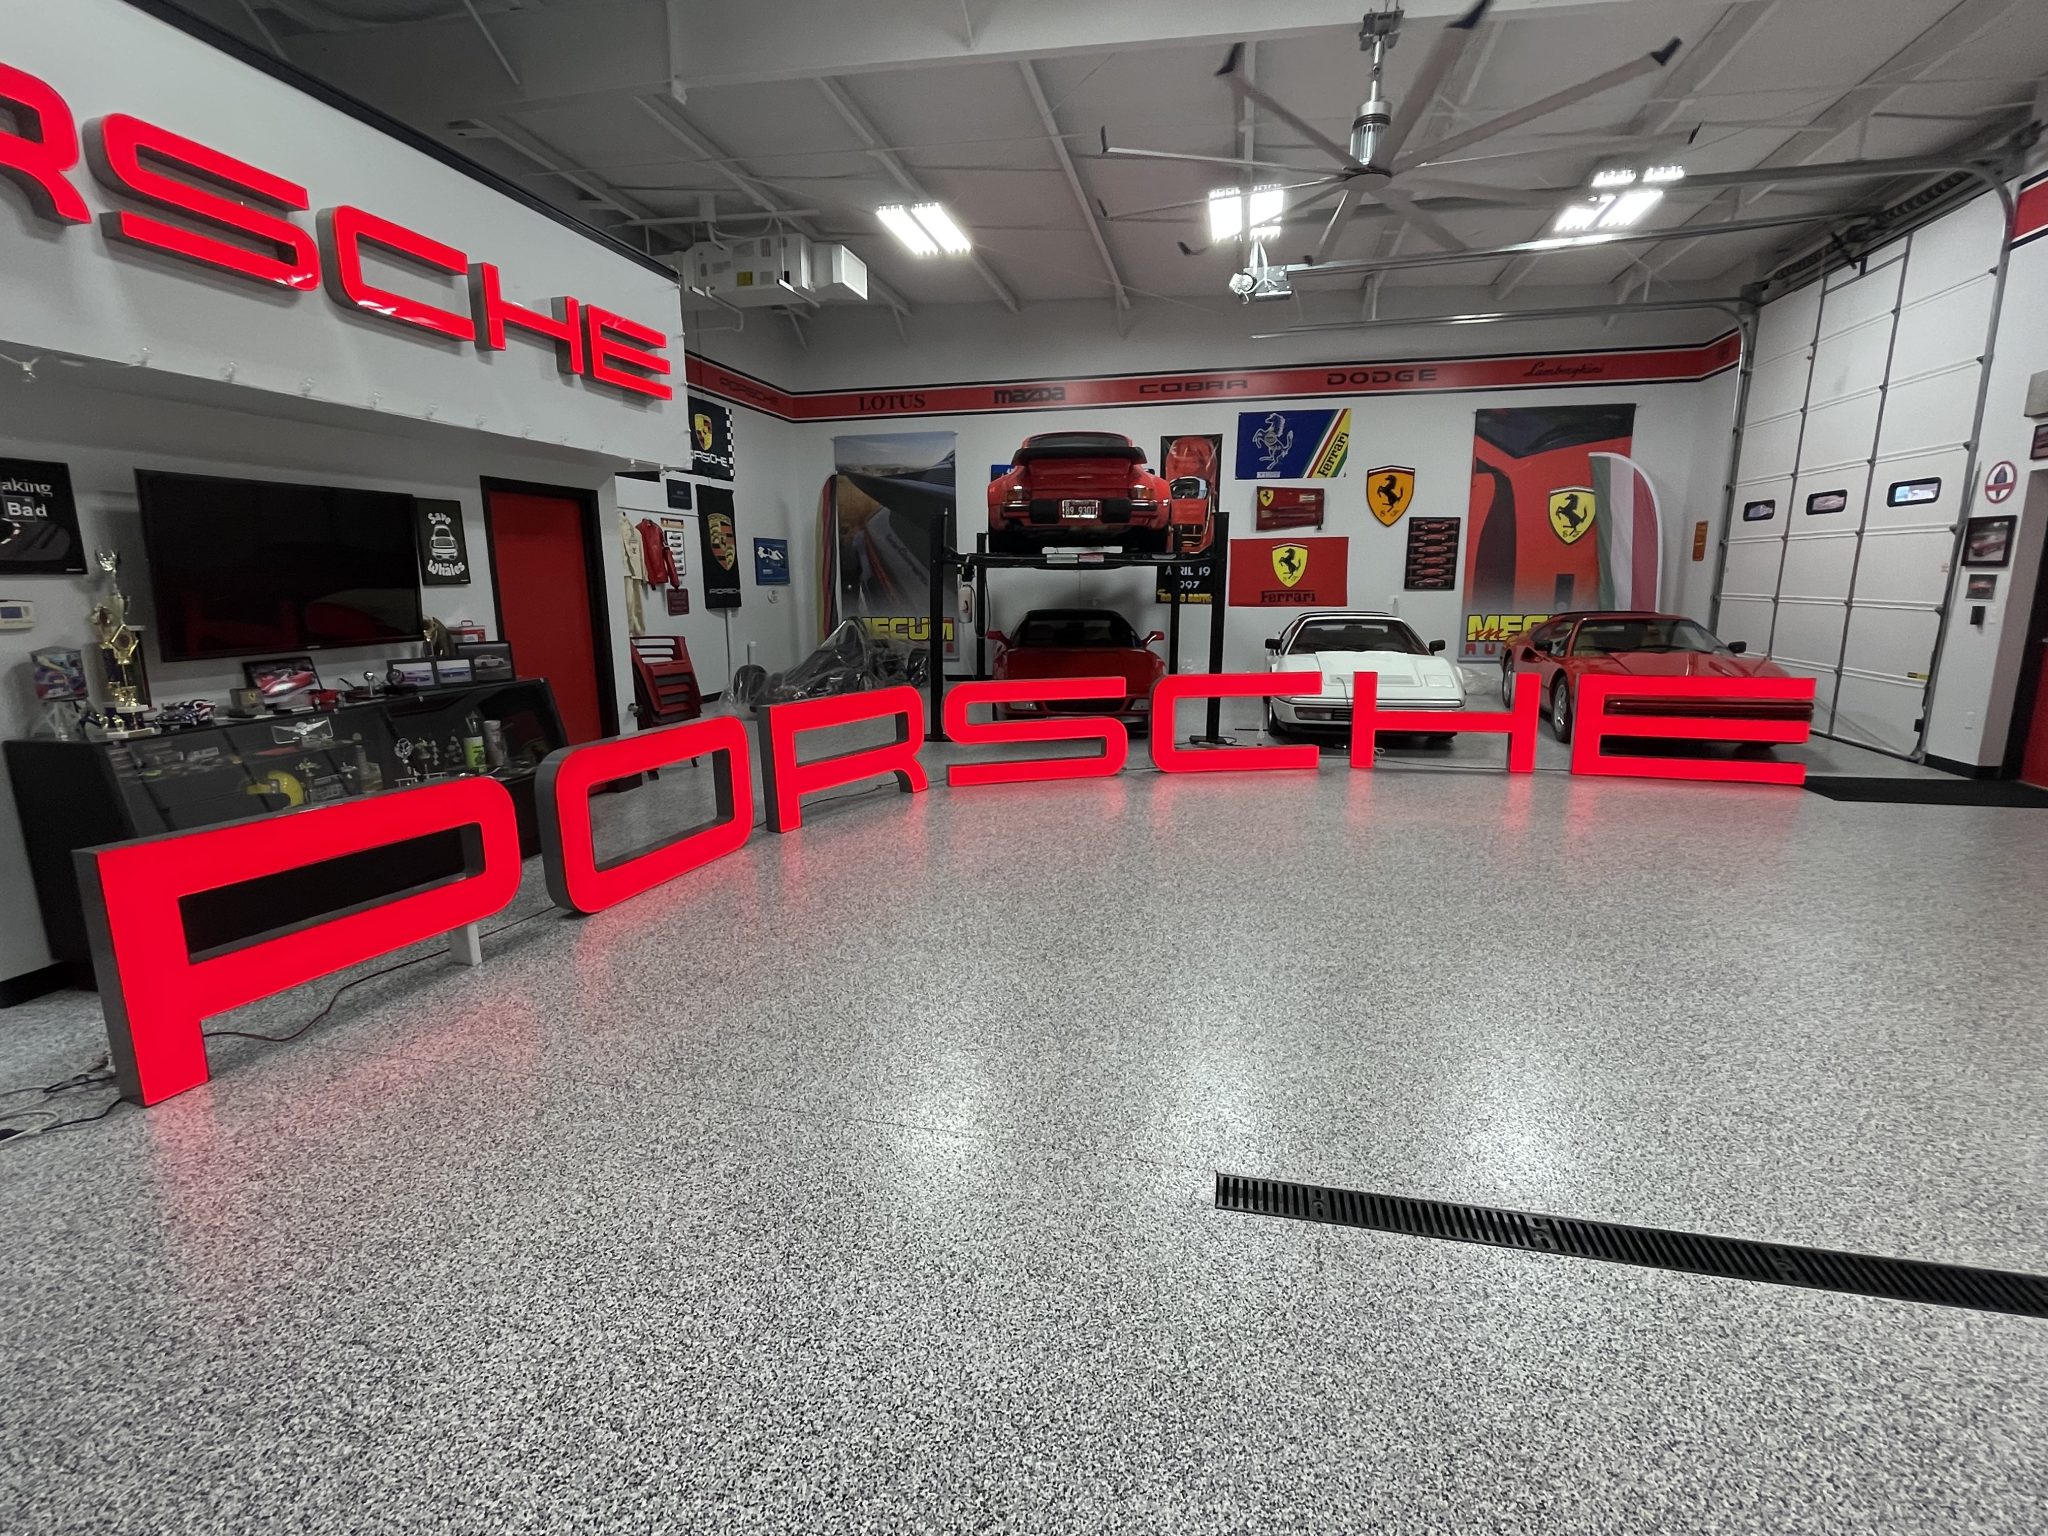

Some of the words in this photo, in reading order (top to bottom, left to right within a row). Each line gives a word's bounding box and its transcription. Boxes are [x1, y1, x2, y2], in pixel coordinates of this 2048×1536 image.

[1327, 369, 1438, 386] DODGE
[1138, 379, 1249, 394] COBRA
[858, 394, 927, 412] LOTUS
[1317, 431, 1350, 479] Ferrari
[7, 501, 48, 518] Bad
[427, 512, 452, 525] Save
[427, 559, 465, 576] Whales
[1260, 589, 1316, 604] Ferrari
[76, 671, 1817, 1107] PORSCHE
